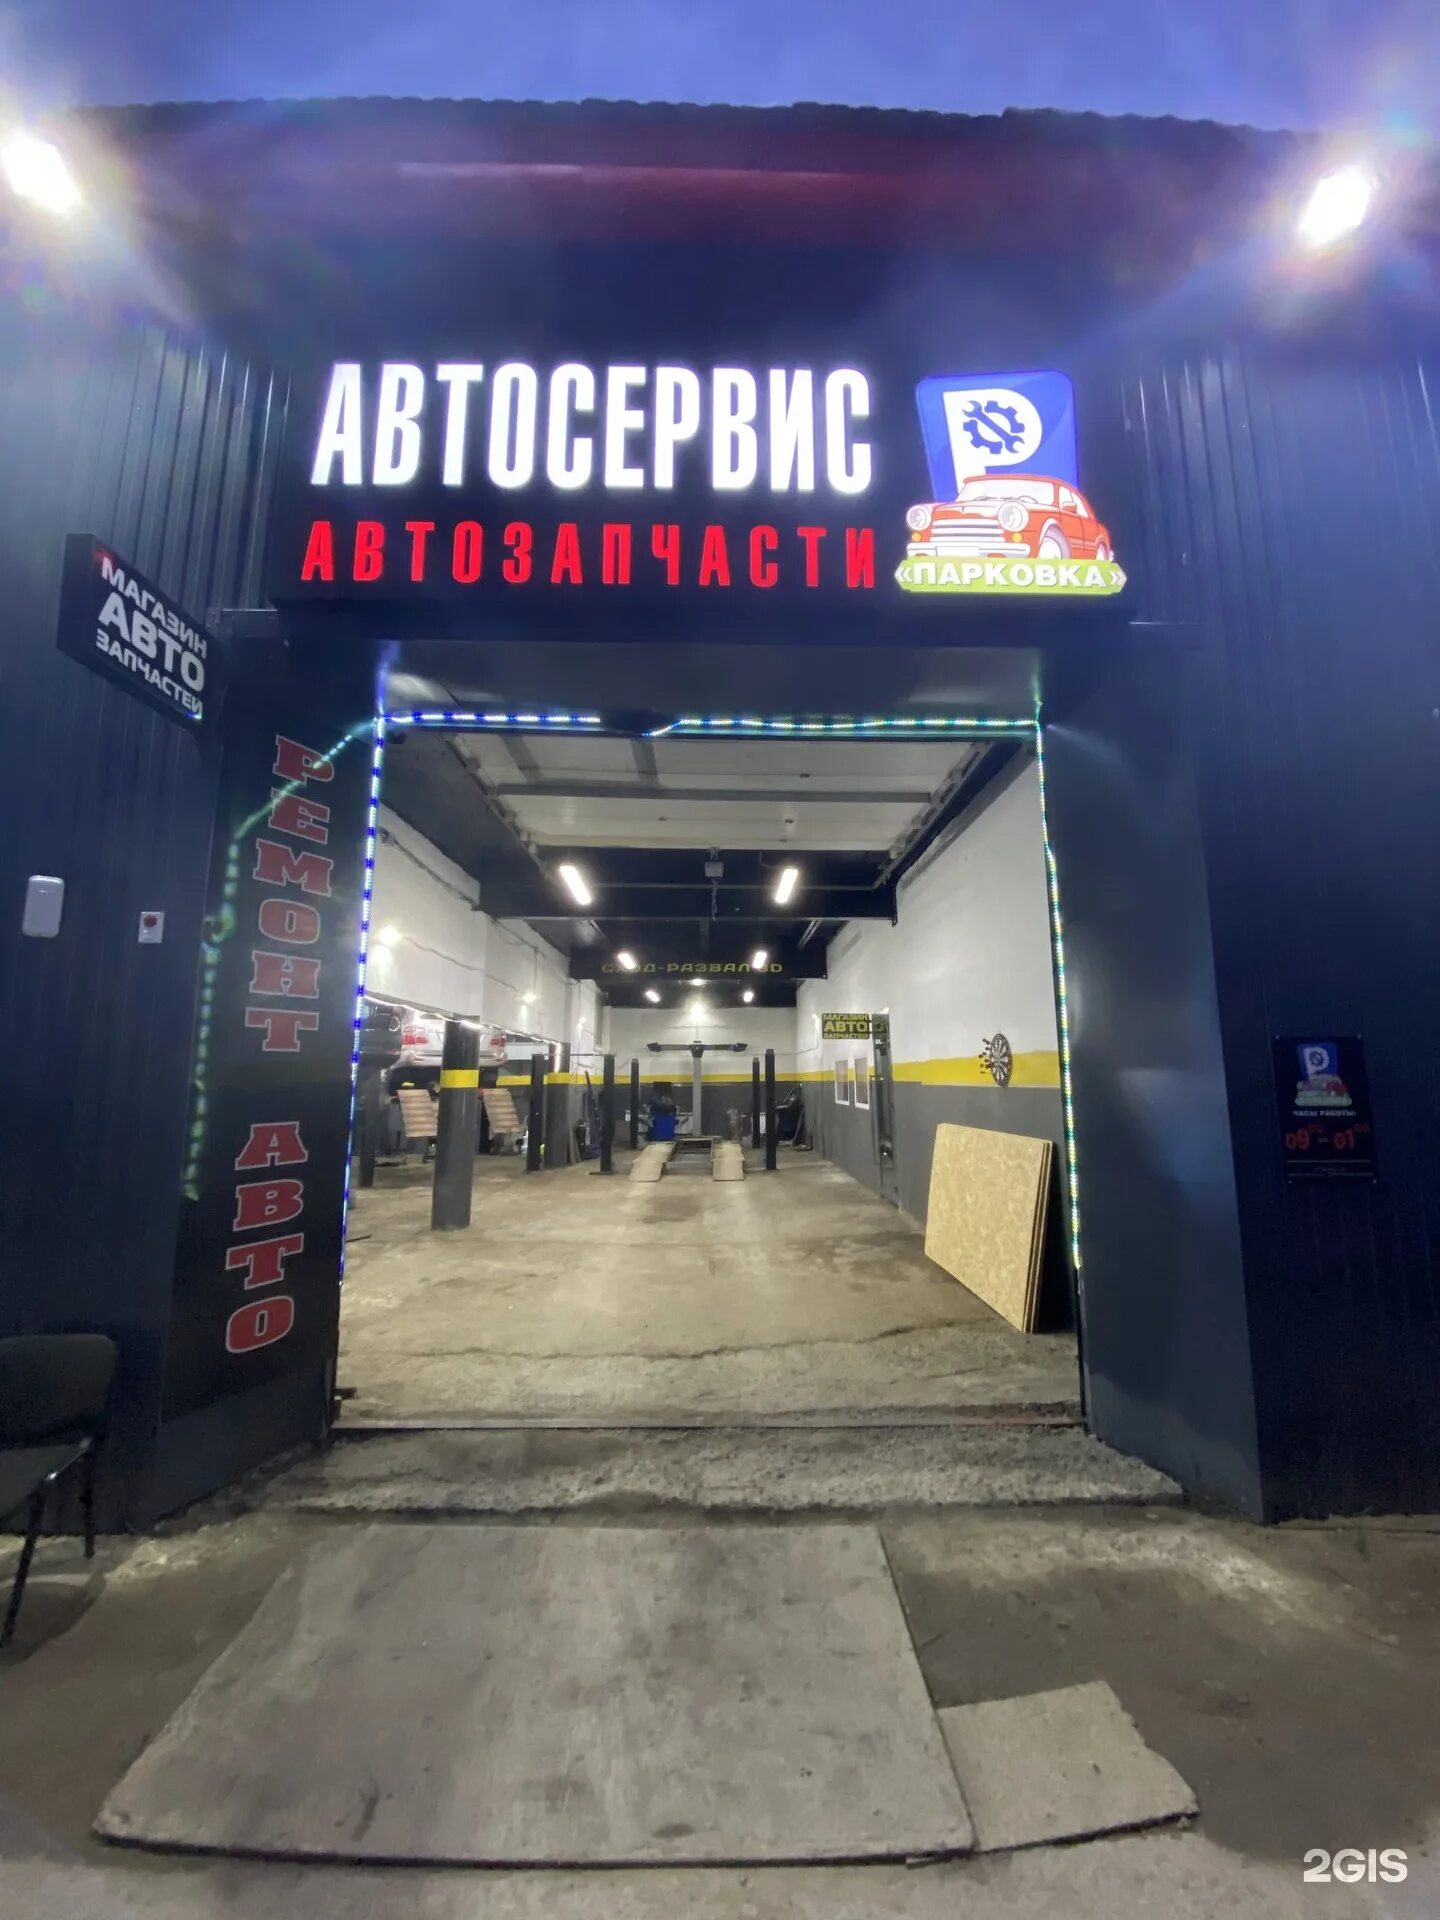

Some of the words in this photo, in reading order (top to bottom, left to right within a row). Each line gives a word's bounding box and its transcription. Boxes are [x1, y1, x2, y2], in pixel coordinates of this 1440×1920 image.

[310, 362, 872, 494] АВТОСЕРВИС
[301, 521, 875, 587] АВТОЗАПЧАСТИ
[99, 592, 205, 692] АВТО
[102, 556, 207, 659] МАГАЗИН
[245, 734, 335, 1052] РЕМОНТ
[823, 1021, 868, 1032] АВТО
[225, 1121, 308, 1353] АВТО
